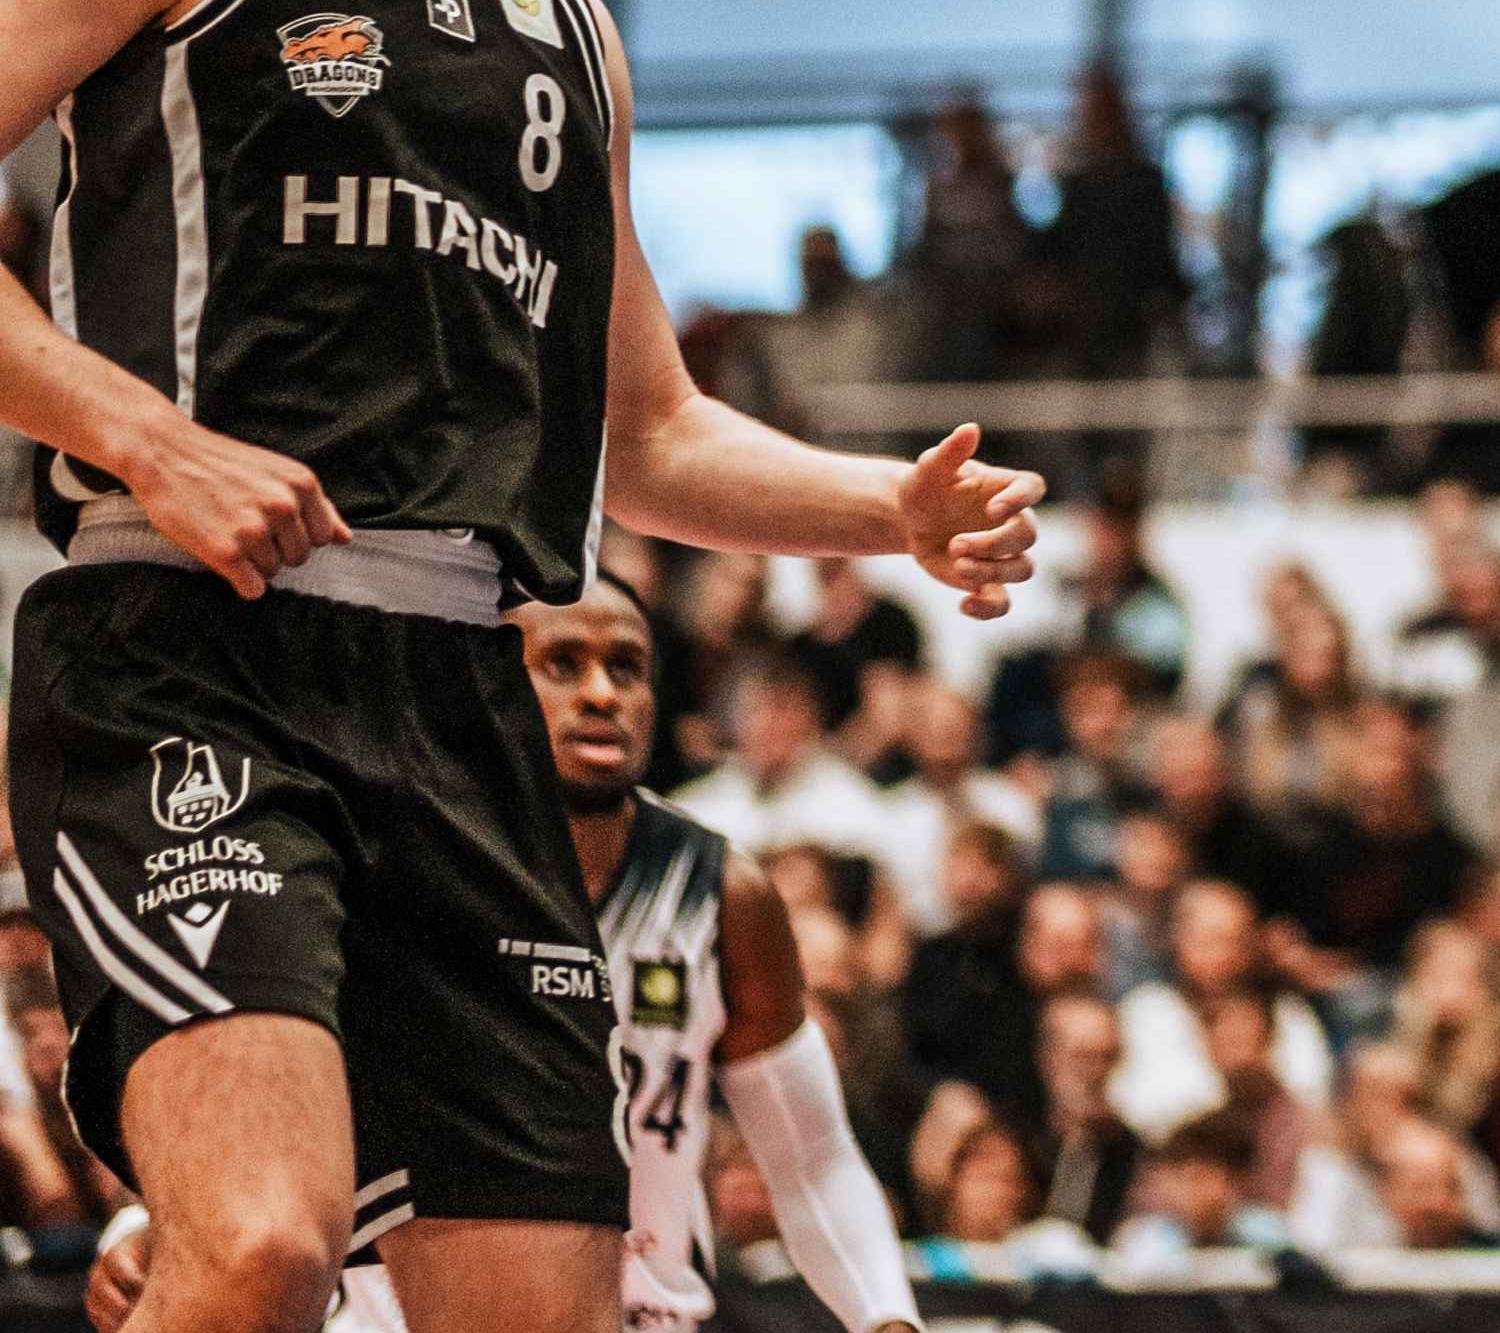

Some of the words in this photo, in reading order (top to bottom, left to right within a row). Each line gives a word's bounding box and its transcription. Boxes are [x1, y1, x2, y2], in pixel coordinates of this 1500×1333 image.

[291, 64, 378, 86] DRAGONS
[518, 73, 566, 192] 8
[283, 175, 559, 329] HITACHI
[144, 835, 265, 880] SCHLOSS
[136, 868, 283, 915] HAGERHOF
[531, 964, 595, 998] RSM
